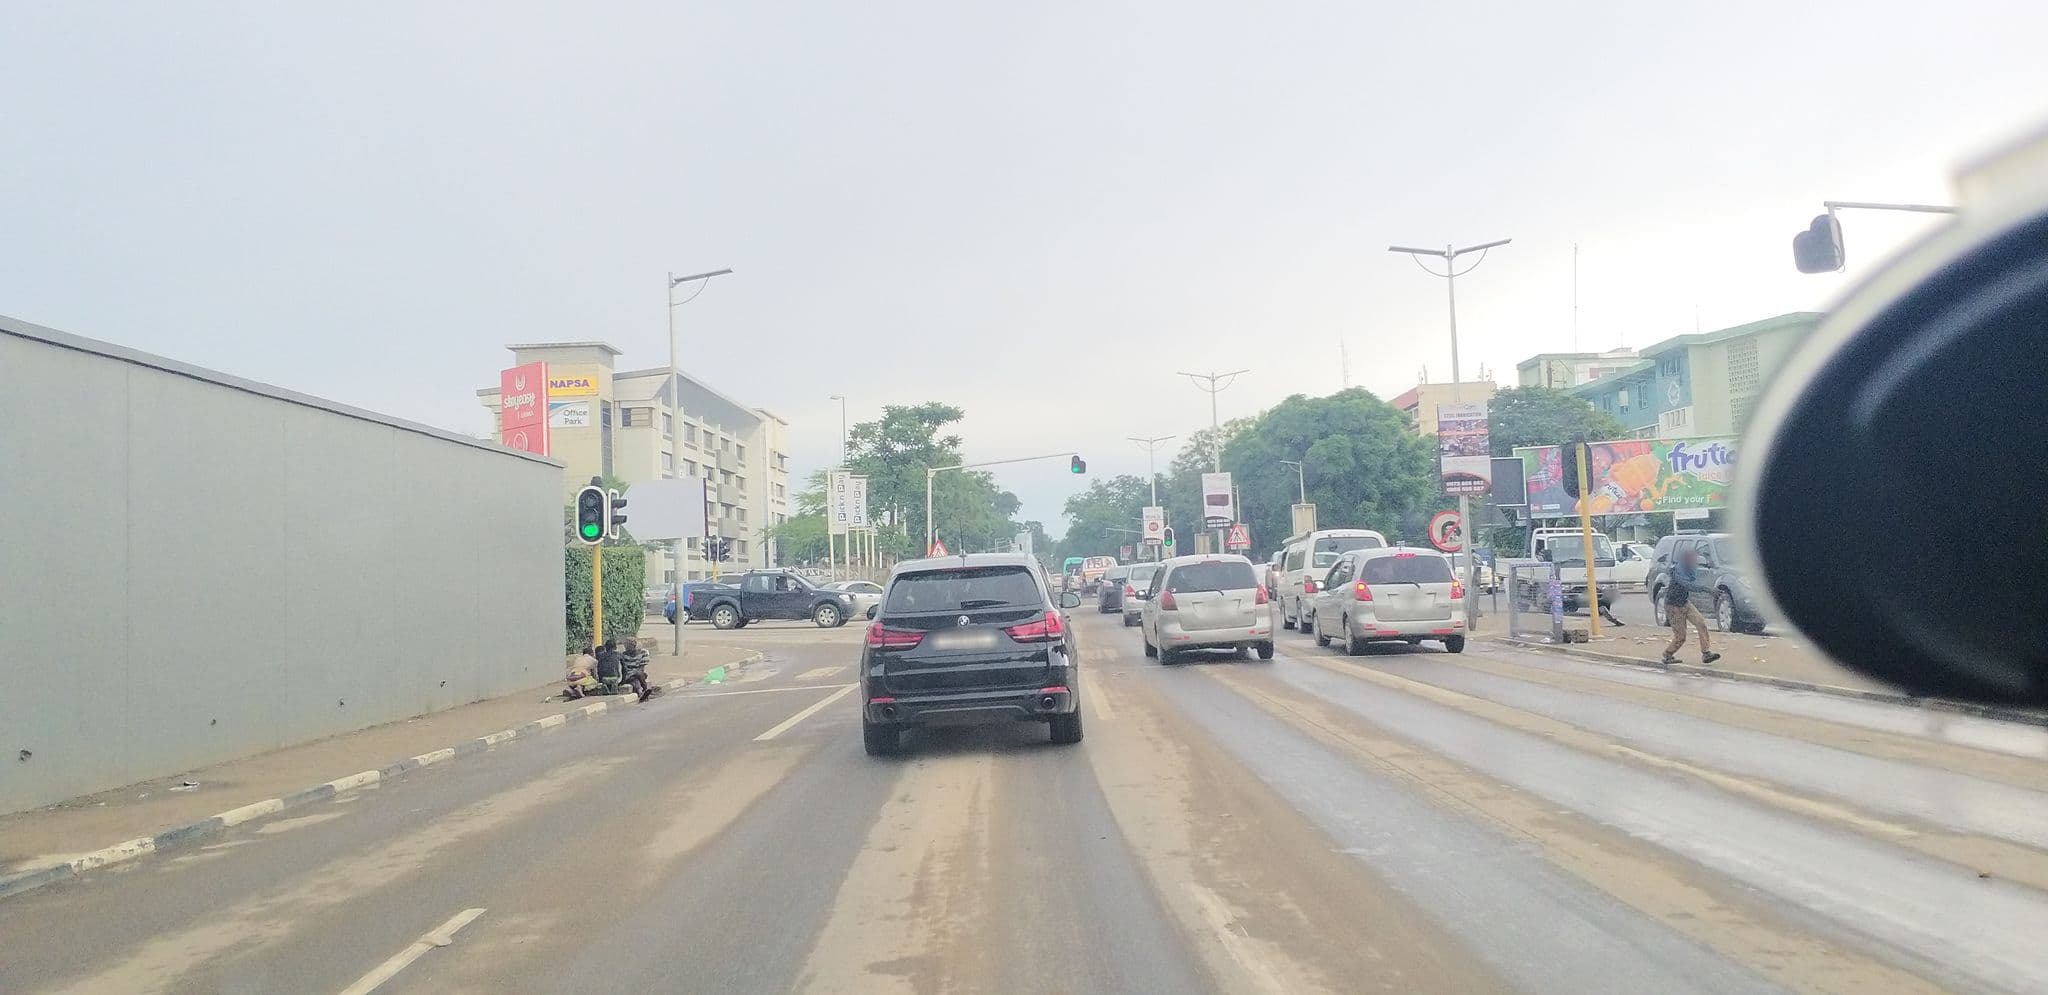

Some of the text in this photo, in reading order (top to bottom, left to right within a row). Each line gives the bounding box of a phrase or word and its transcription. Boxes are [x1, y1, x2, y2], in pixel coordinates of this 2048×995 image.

[550, 379, 589, 388] NAPSA
[563, 409, 588, 417] Office
[564, 417, 583, 425] Park
[1662, 496, 1682, 504] Find
[1685, 496, 1705, 505] your
